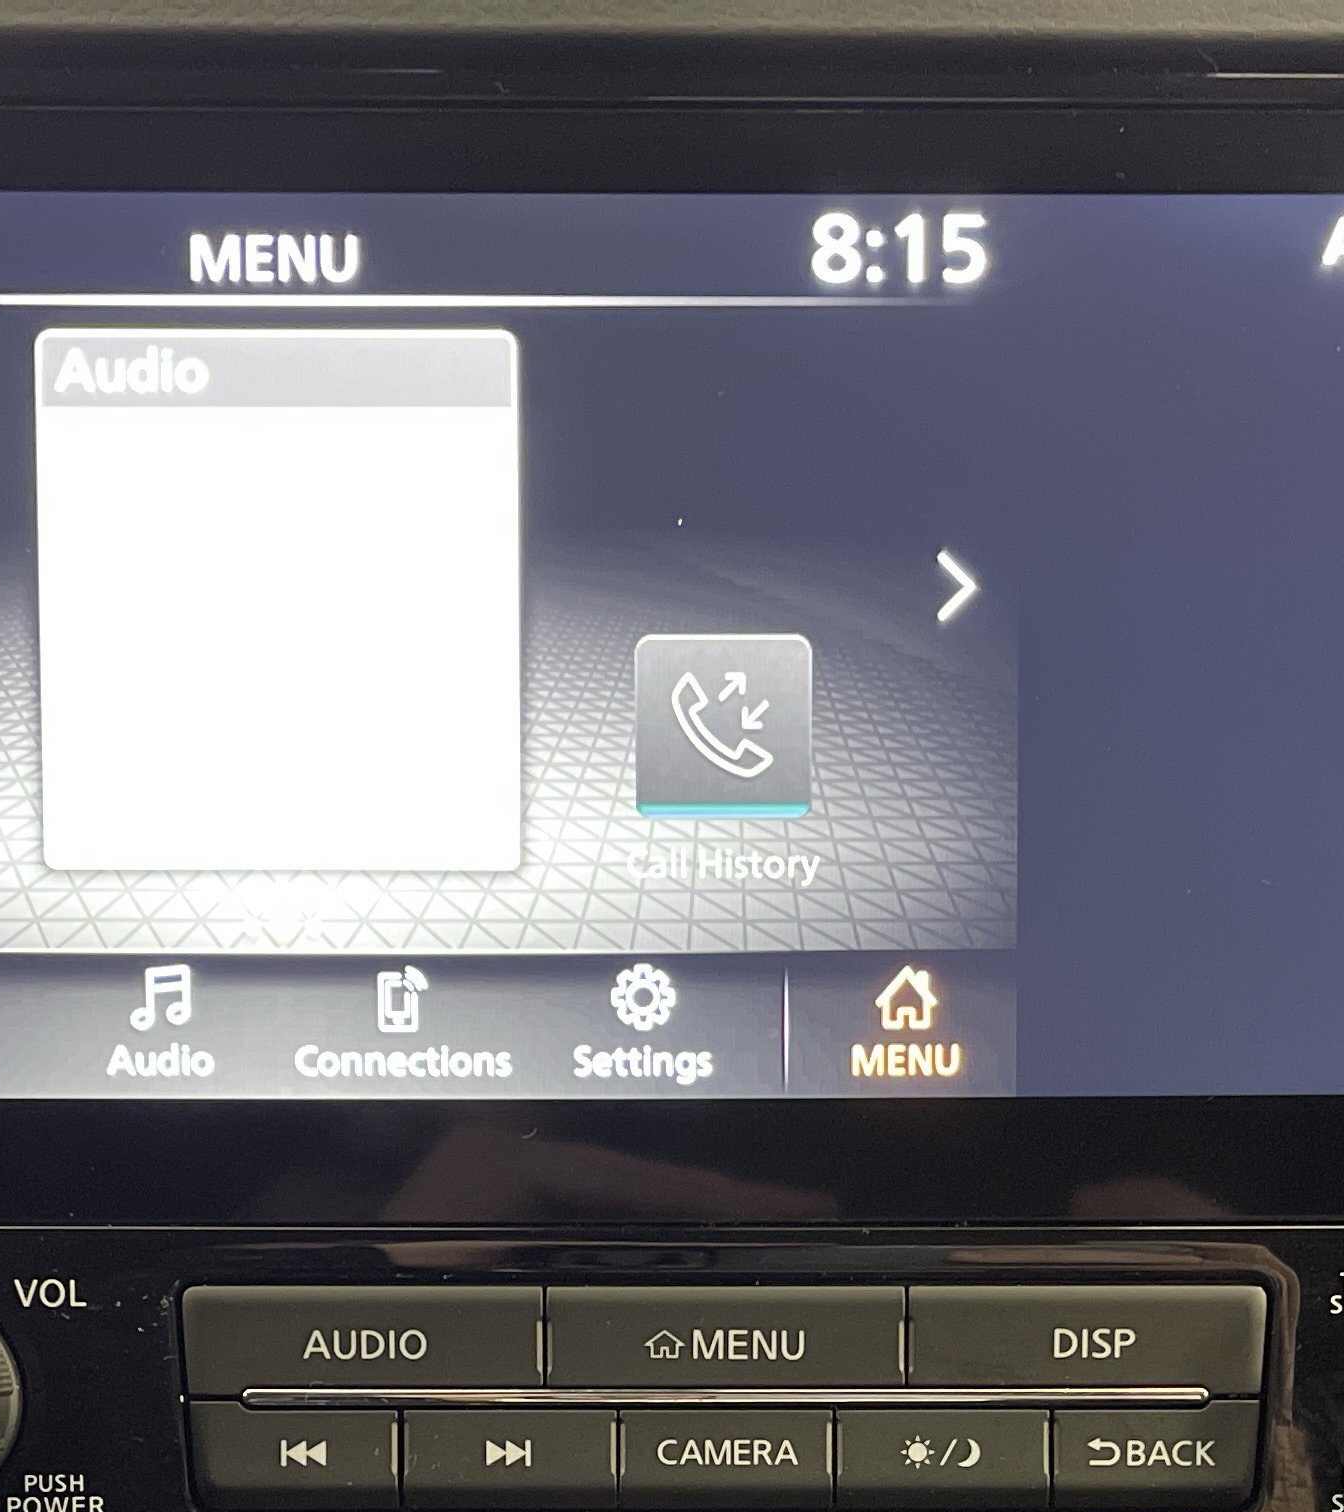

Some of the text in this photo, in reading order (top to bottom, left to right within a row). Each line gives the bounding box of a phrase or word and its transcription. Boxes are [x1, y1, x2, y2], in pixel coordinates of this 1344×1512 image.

[188, 232, 360, 283] MENU
[810, 213, 989, 286] 8:15
[54, 346, 210, 396] Audio
[626, 846, 821, 887] Call History
[106, 1042, 215, 1080] Audio
[294, 1043, 513, 1080] Connections
[573, 1043, 713, 1086] Settings
[850, 1043, 959, 1079] MENU
[14, 1280, 88, 1309] VOL
[302, 1329, 429, 1361] AUDIO
[691, 1329, 807, 1361] MENU
[1053, 1328, 1137, 1360] DISP
[657, 1439, 799, 1467] CAMERA
[1126, 1440, 1216, 1467] BACK
[24, 1474, 85, 1494] PUSH
